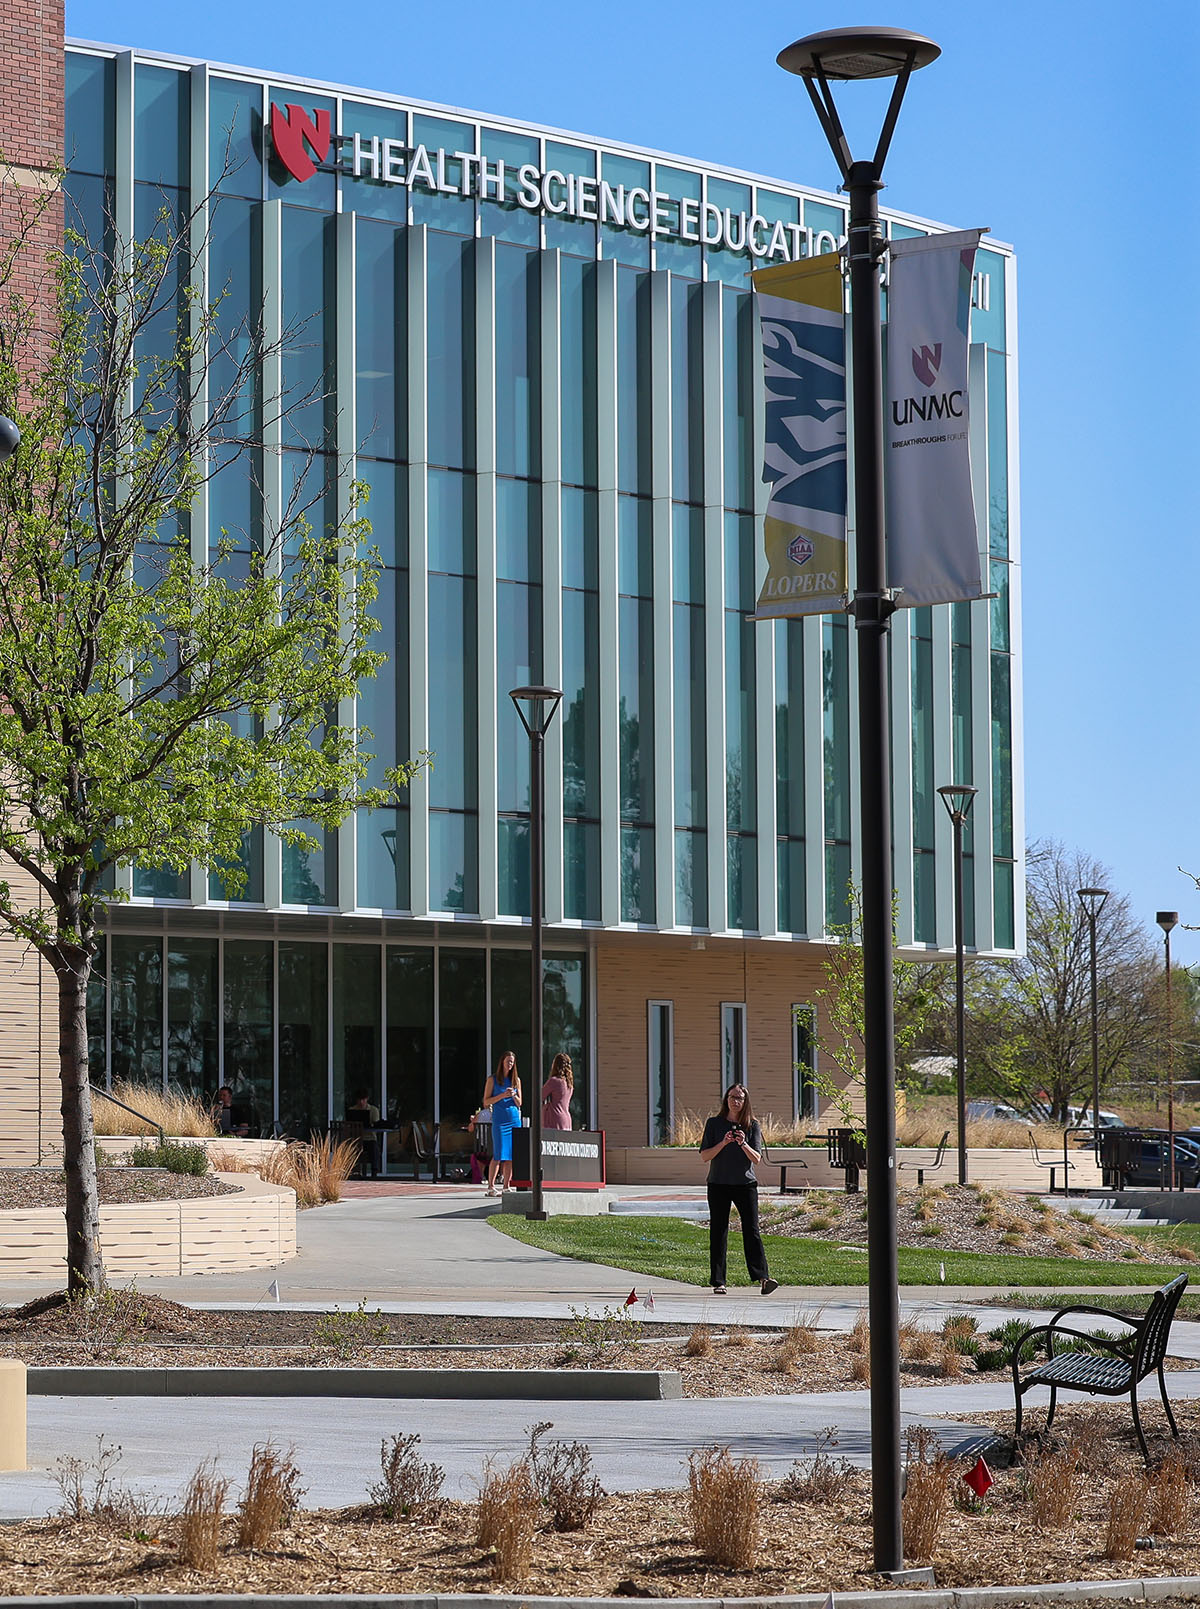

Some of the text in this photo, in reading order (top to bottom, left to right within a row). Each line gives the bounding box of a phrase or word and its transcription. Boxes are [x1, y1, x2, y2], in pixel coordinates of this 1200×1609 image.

[352, 132, 504, 202] HEALTH
[517, 164, 670, 235] SCIENCE
[892, 390, 963, 427] UNMC
[892, 434, 946, 449] BREAKTHROUGHS
[790, 544, 812, 556] MIAA
[767, 570, 837, 597] LOPERS
